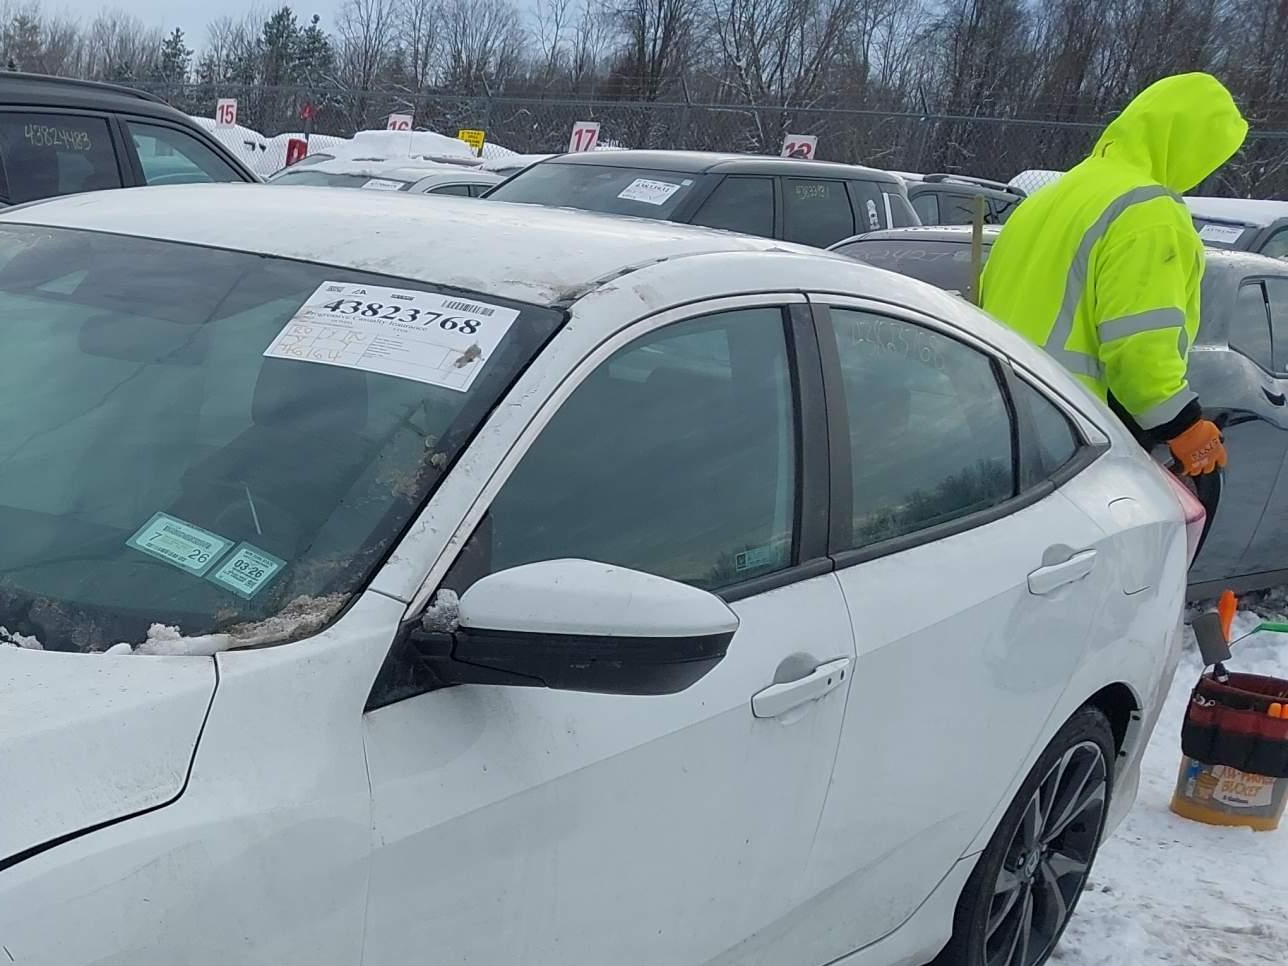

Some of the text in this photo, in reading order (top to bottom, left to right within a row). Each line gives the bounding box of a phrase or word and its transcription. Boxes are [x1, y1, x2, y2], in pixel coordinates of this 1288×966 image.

[218, 104, 235, 124] 15
[574, 128, 597, 152] 17
[322, 298, 482, 335] 43823768
[388, 320, 429, 332] Insurance
[149, 531, 163, 541] 7
[187, 548, 210, 563] 26
